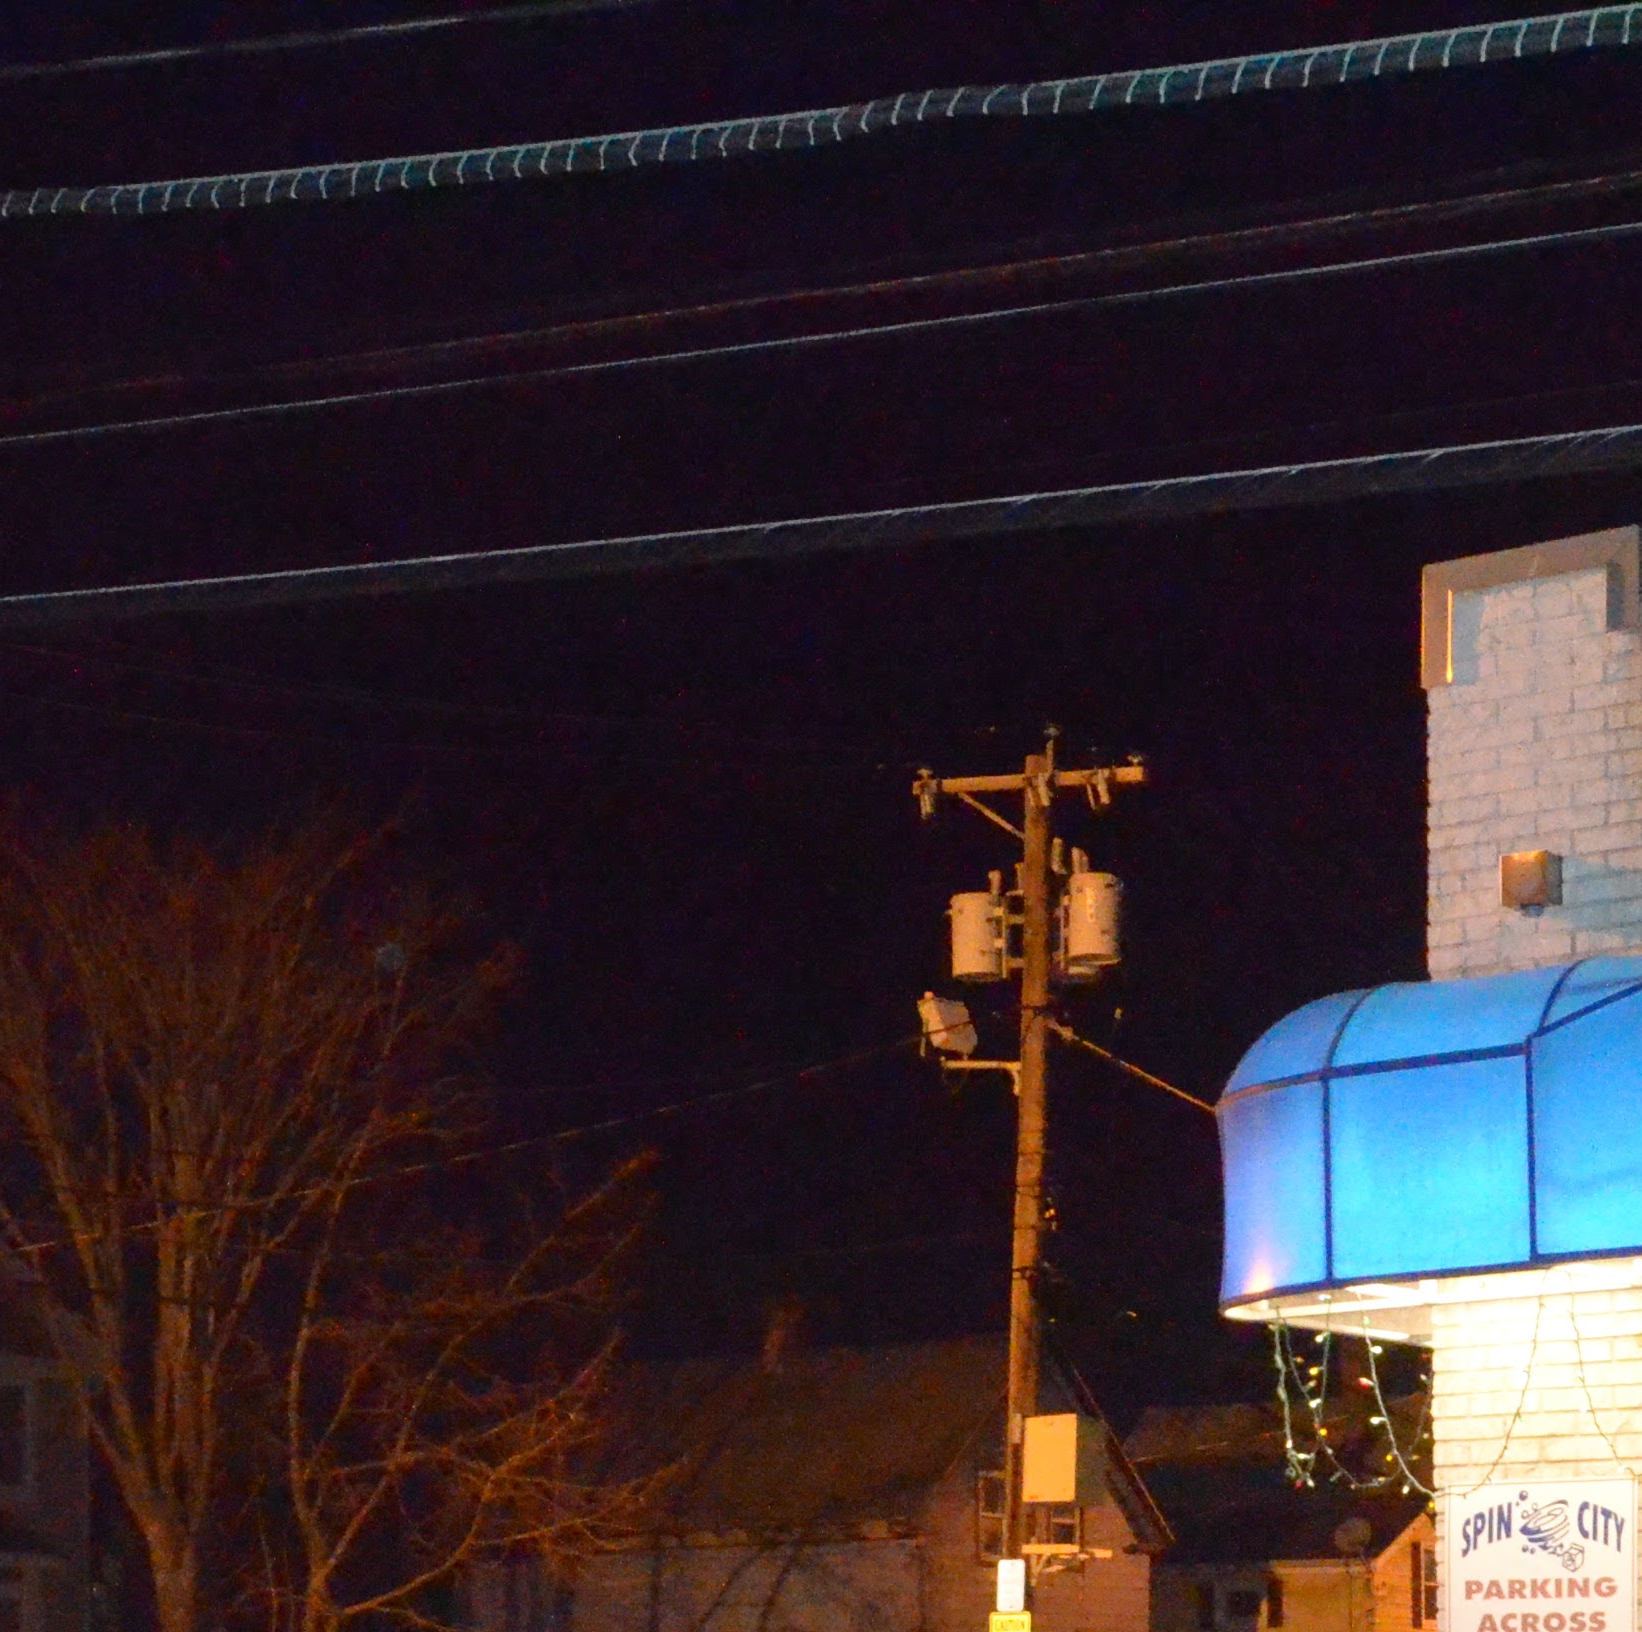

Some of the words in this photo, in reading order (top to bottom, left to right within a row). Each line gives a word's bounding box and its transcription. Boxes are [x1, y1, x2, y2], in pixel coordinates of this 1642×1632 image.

[1462, 1502, 1512, 1557] SPIN
[1577, 1501, 1625, 1552] CITY
[1464, 1577, 1618, 1600] PARKING
